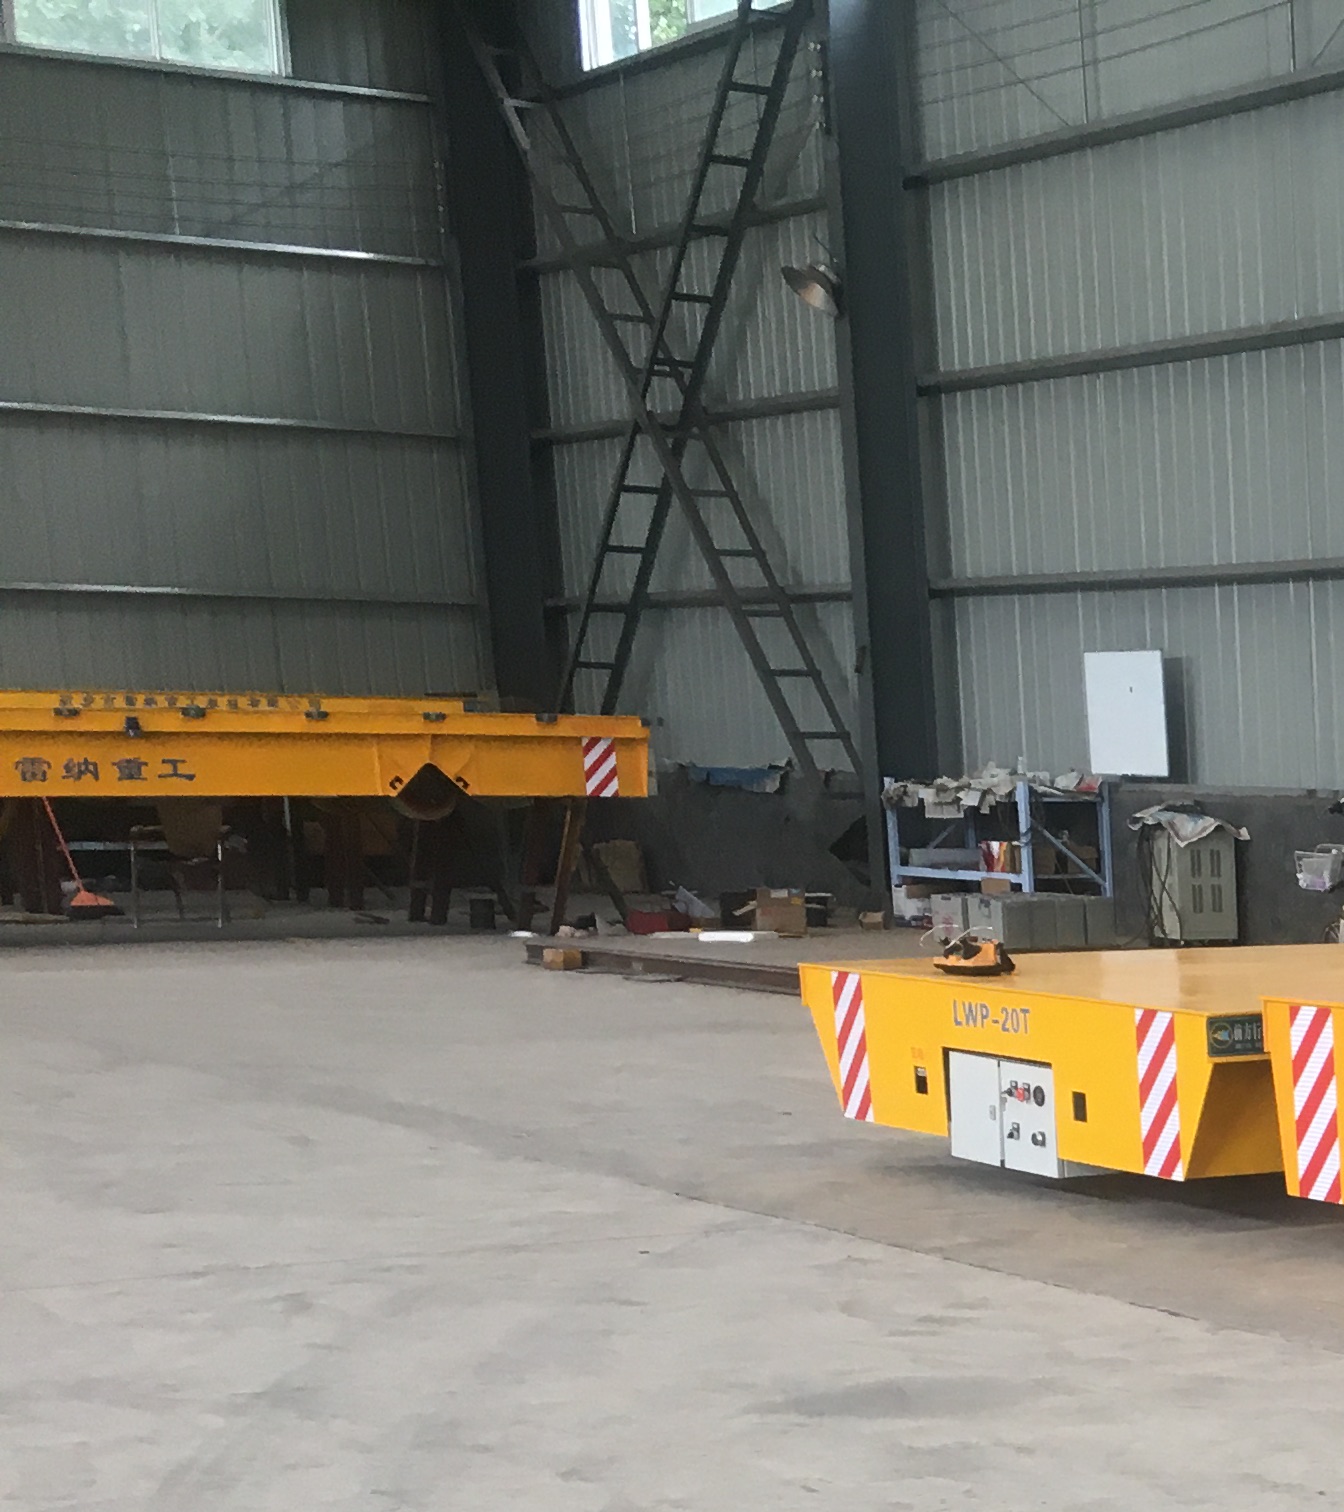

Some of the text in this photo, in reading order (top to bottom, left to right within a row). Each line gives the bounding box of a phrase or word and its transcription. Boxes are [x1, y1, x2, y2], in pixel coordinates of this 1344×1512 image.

[14, 757, 196, 783] 雷纳重工
[952, 999, 1031, 1035] LWP-20T
